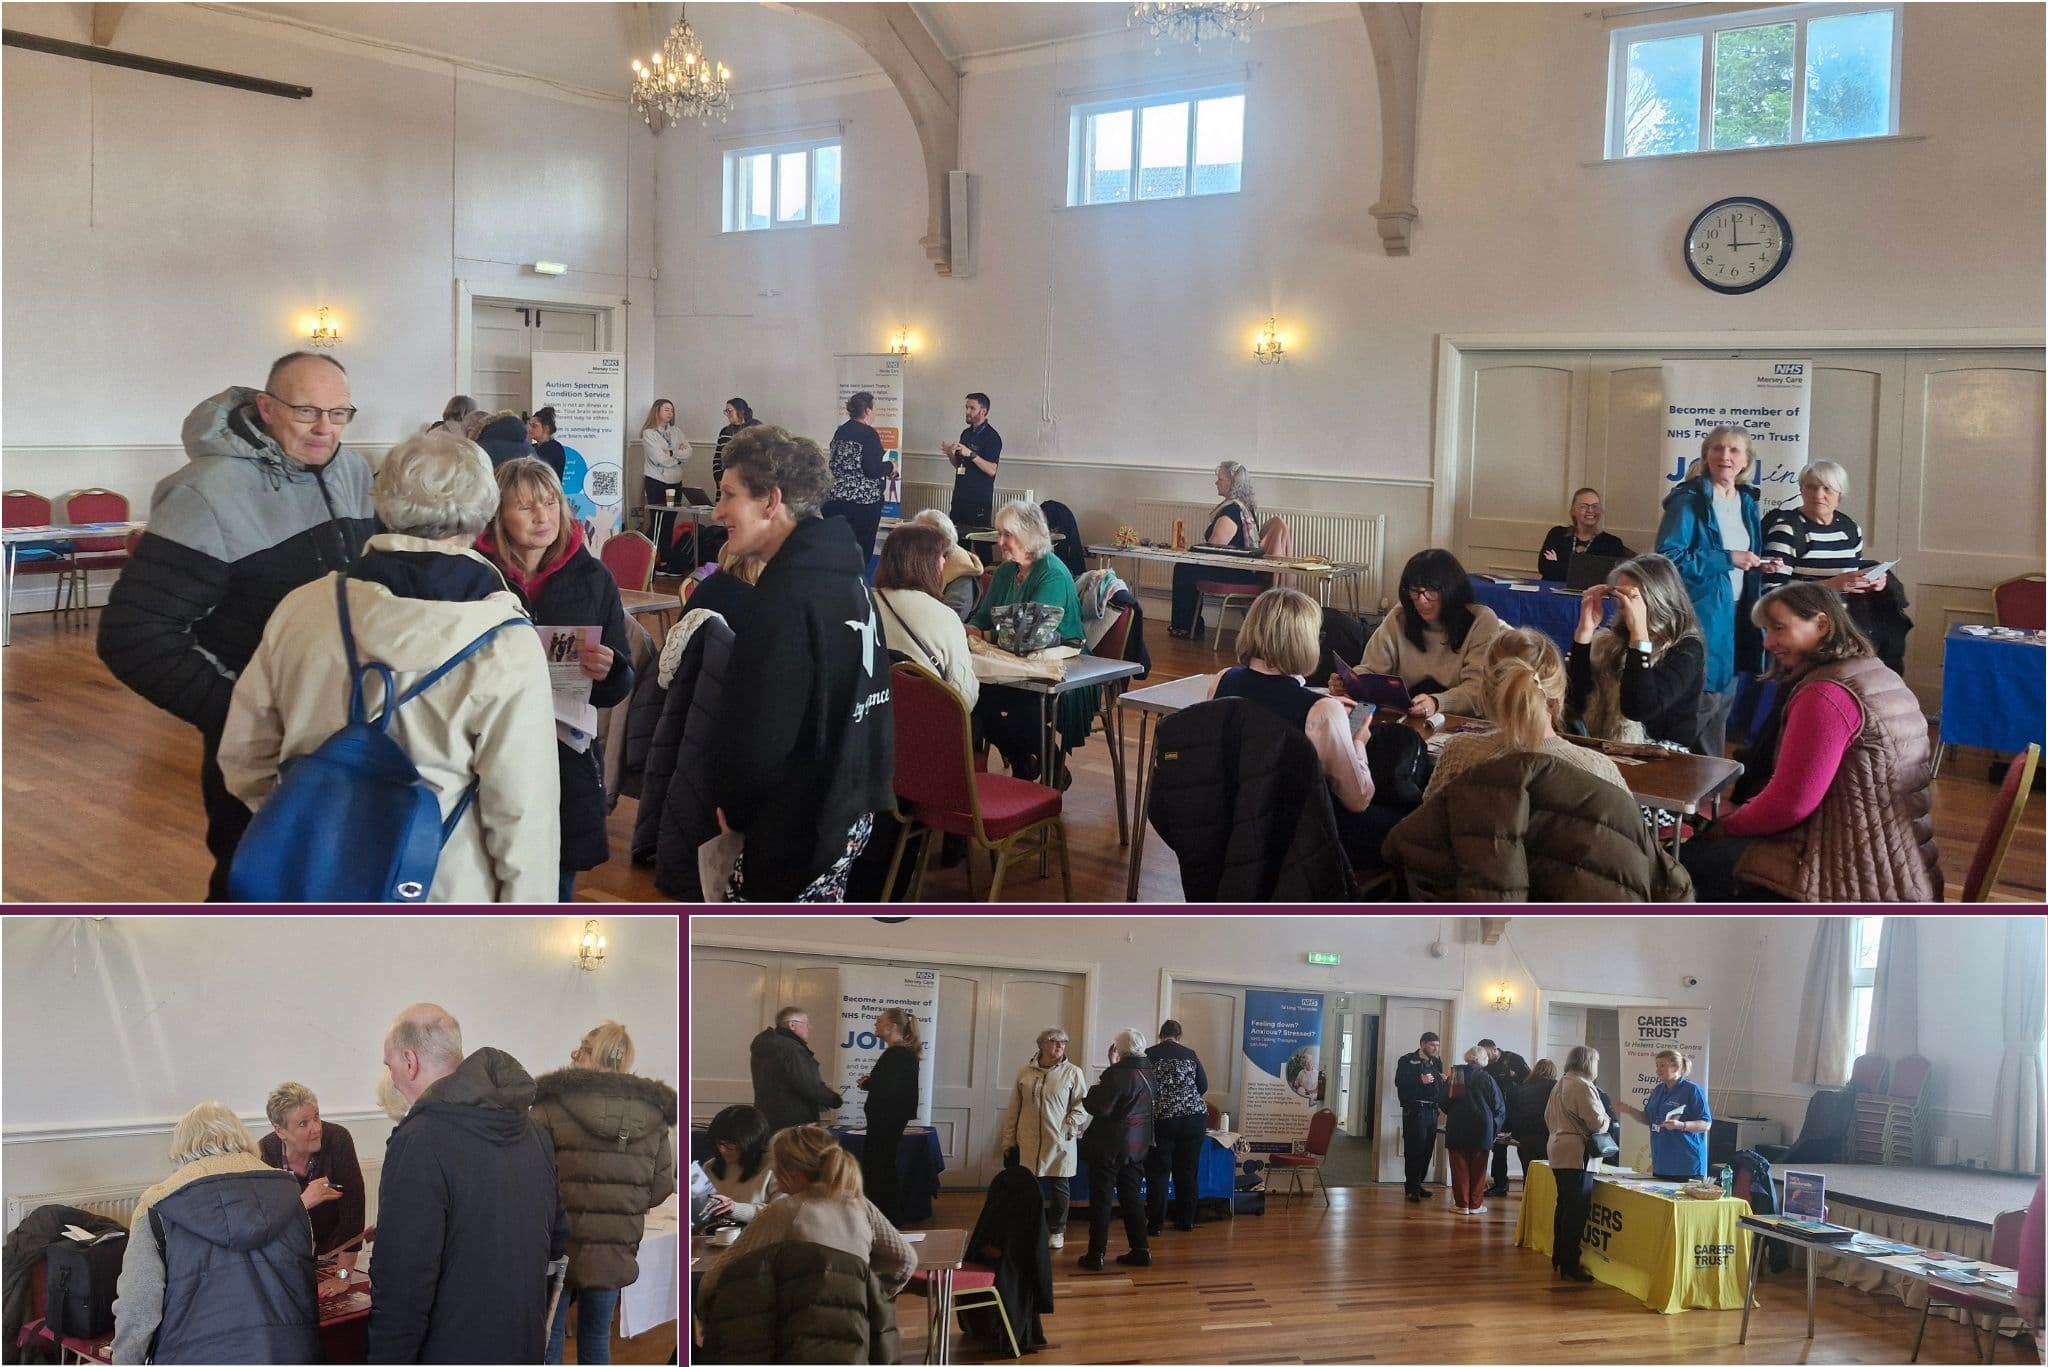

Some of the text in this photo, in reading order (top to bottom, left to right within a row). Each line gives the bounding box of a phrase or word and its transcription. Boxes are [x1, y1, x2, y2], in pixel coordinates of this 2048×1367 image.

[1760, 224, 1766, 233] 2
[1707, 230, 1718, 239] 10
[1701, 242, 1709, 252] 9
[1706, 256, 1714, 265] 8
[1719, 264, 1725, 273] 7
[1731, 267, 1739, 276] 6
[1775, 364, 1802, 374] NHS
[574, 382, 608, 390] Spectrum
[1669, 405, 1716, 414] Become
[1730, 407, 1782, 416] member
[1786, 407, 1800, 416] of
[1744, 420, 1771, 428] Care
[1668, 430, 1690, 438] NHS
[1769, 432, 1800, 442] Trust
[843, 995, 876, 1003] Become
[1252, 1020, 1275, 1028] Feeling
[1637, 1016, 1687, 1027] CARERS
[1638, 1027, 1679, 1038] TRUST
[1694, 1244, 1734, 1254] CARERS
[1695, 1256, 1728, 1265] TRUST
